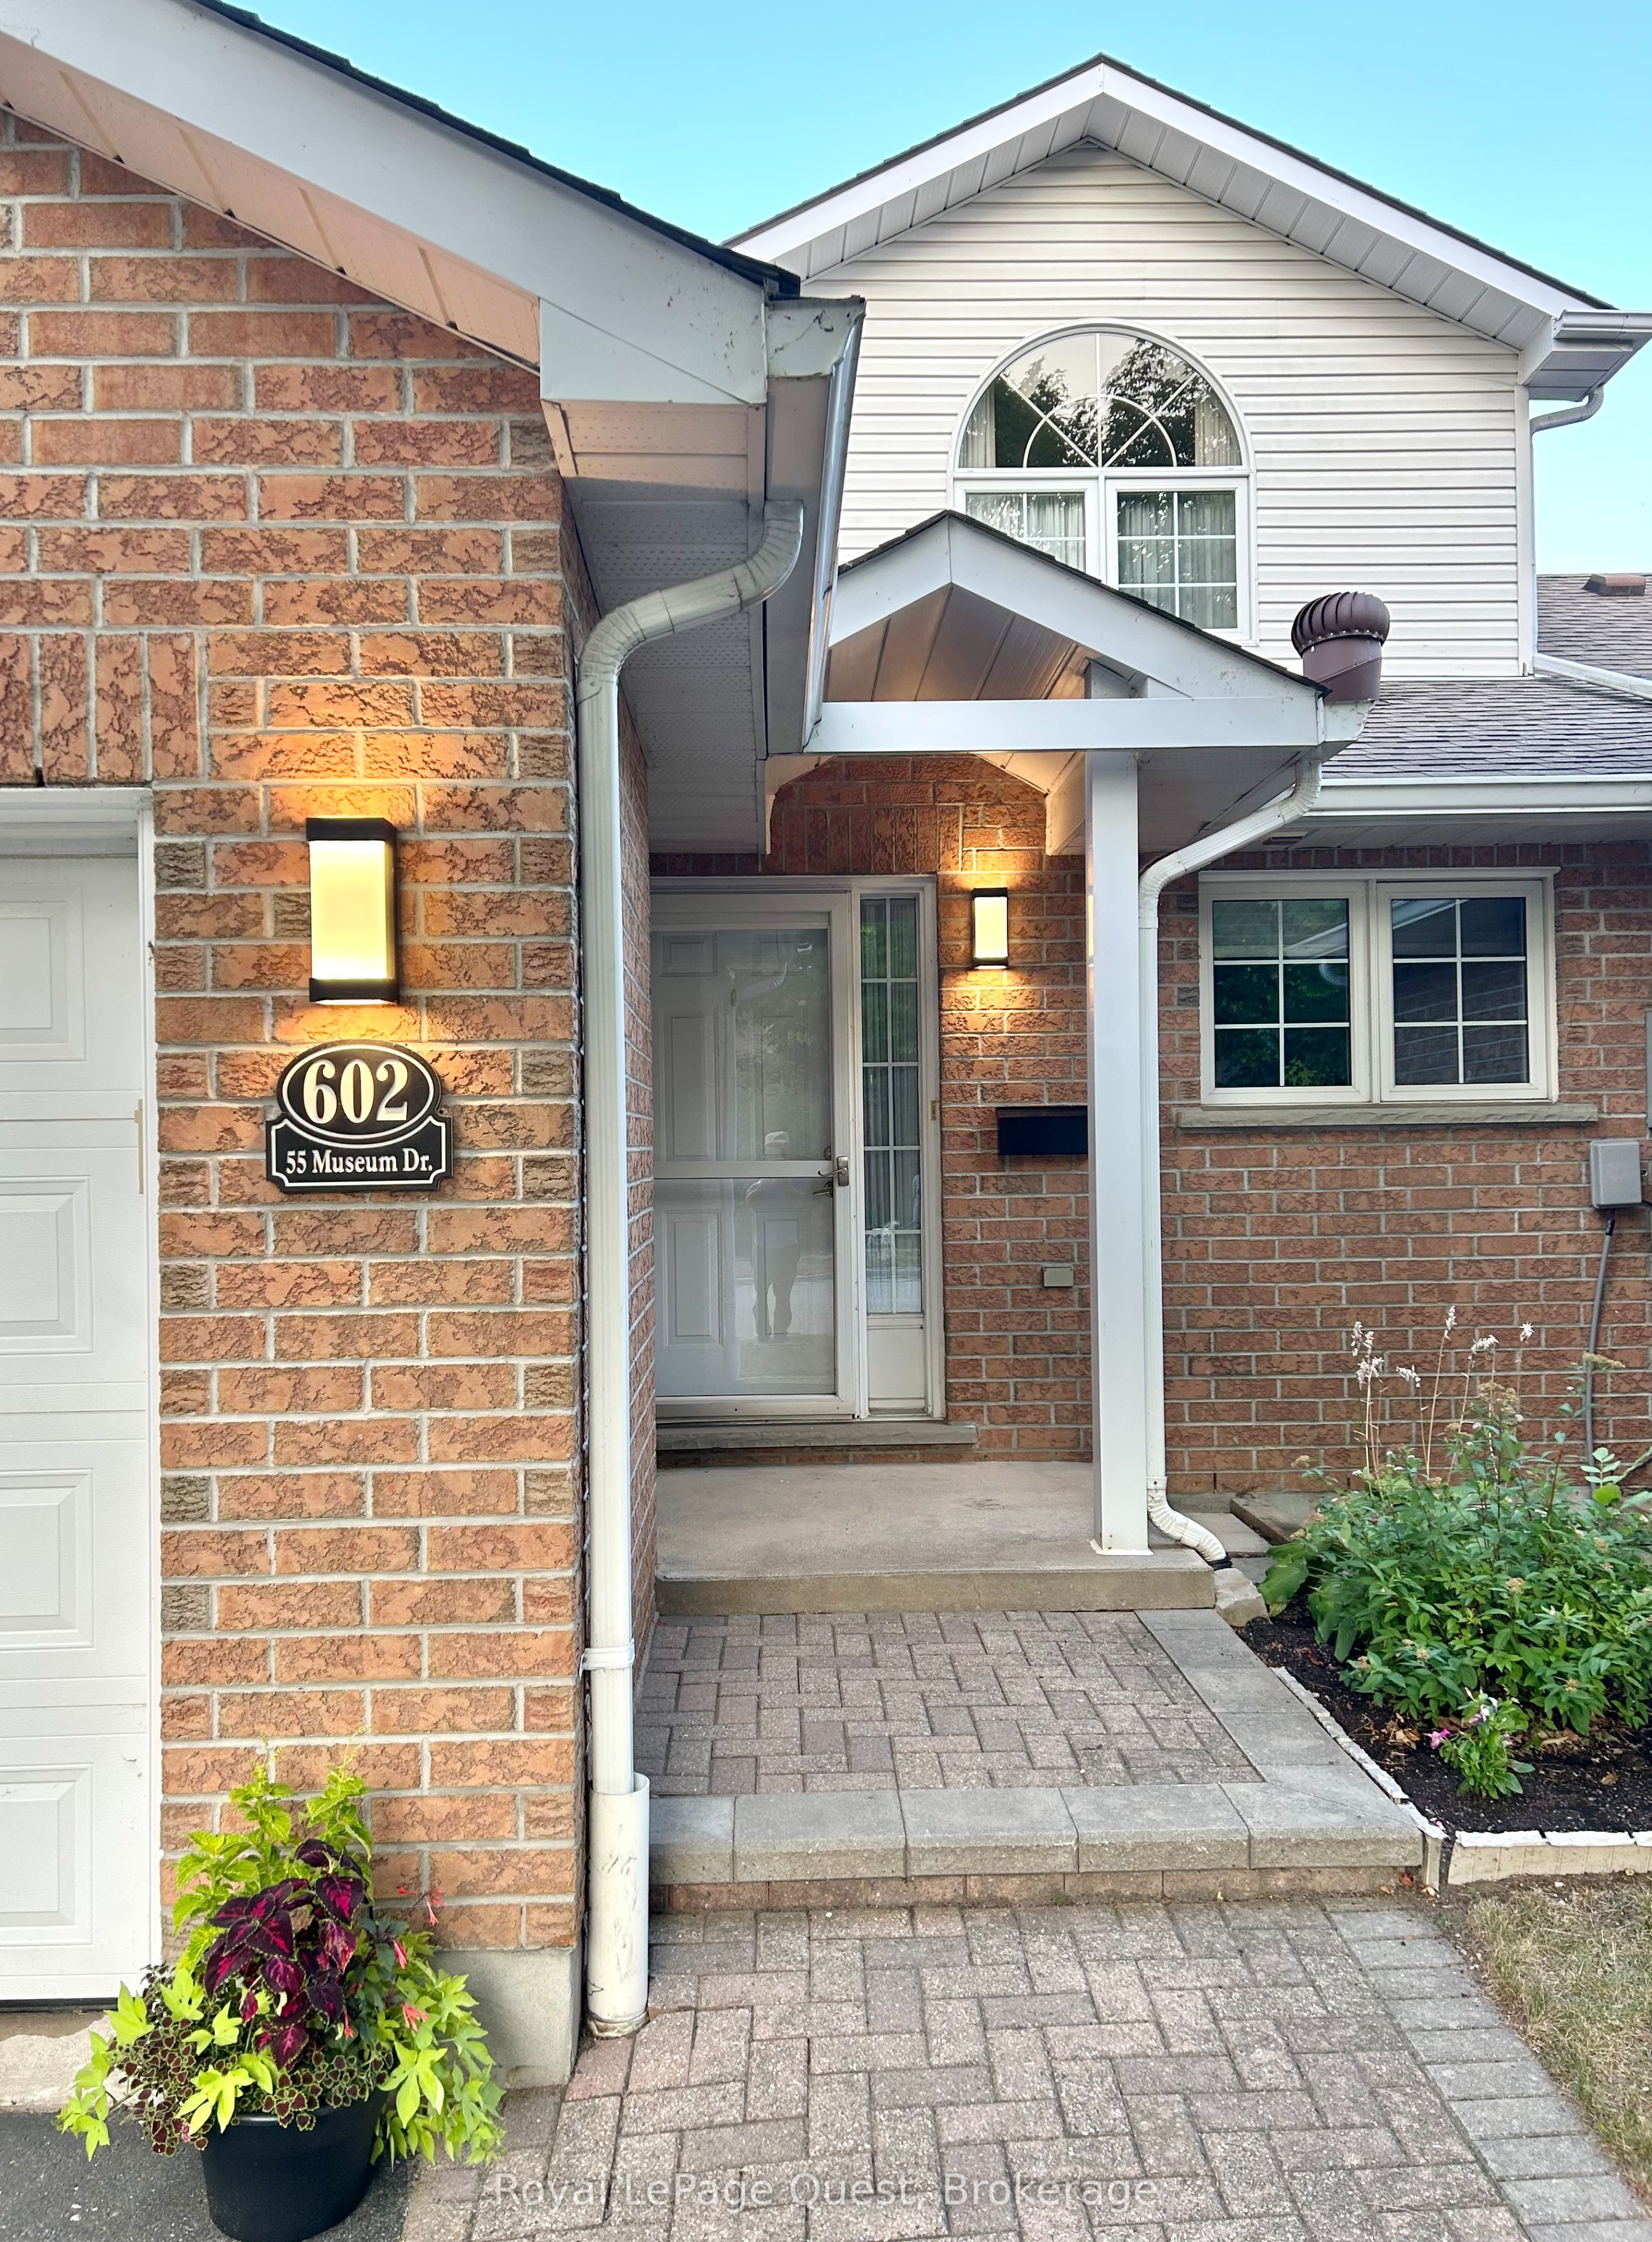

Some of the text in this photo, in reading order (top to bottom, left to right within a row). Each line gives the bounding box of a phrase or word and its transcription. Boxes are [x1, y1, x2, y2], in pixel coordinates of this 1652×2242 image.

[303, 1059, 408, 1124] 602
[285, 1148, 433, 1174] 55 Museum Dr.
